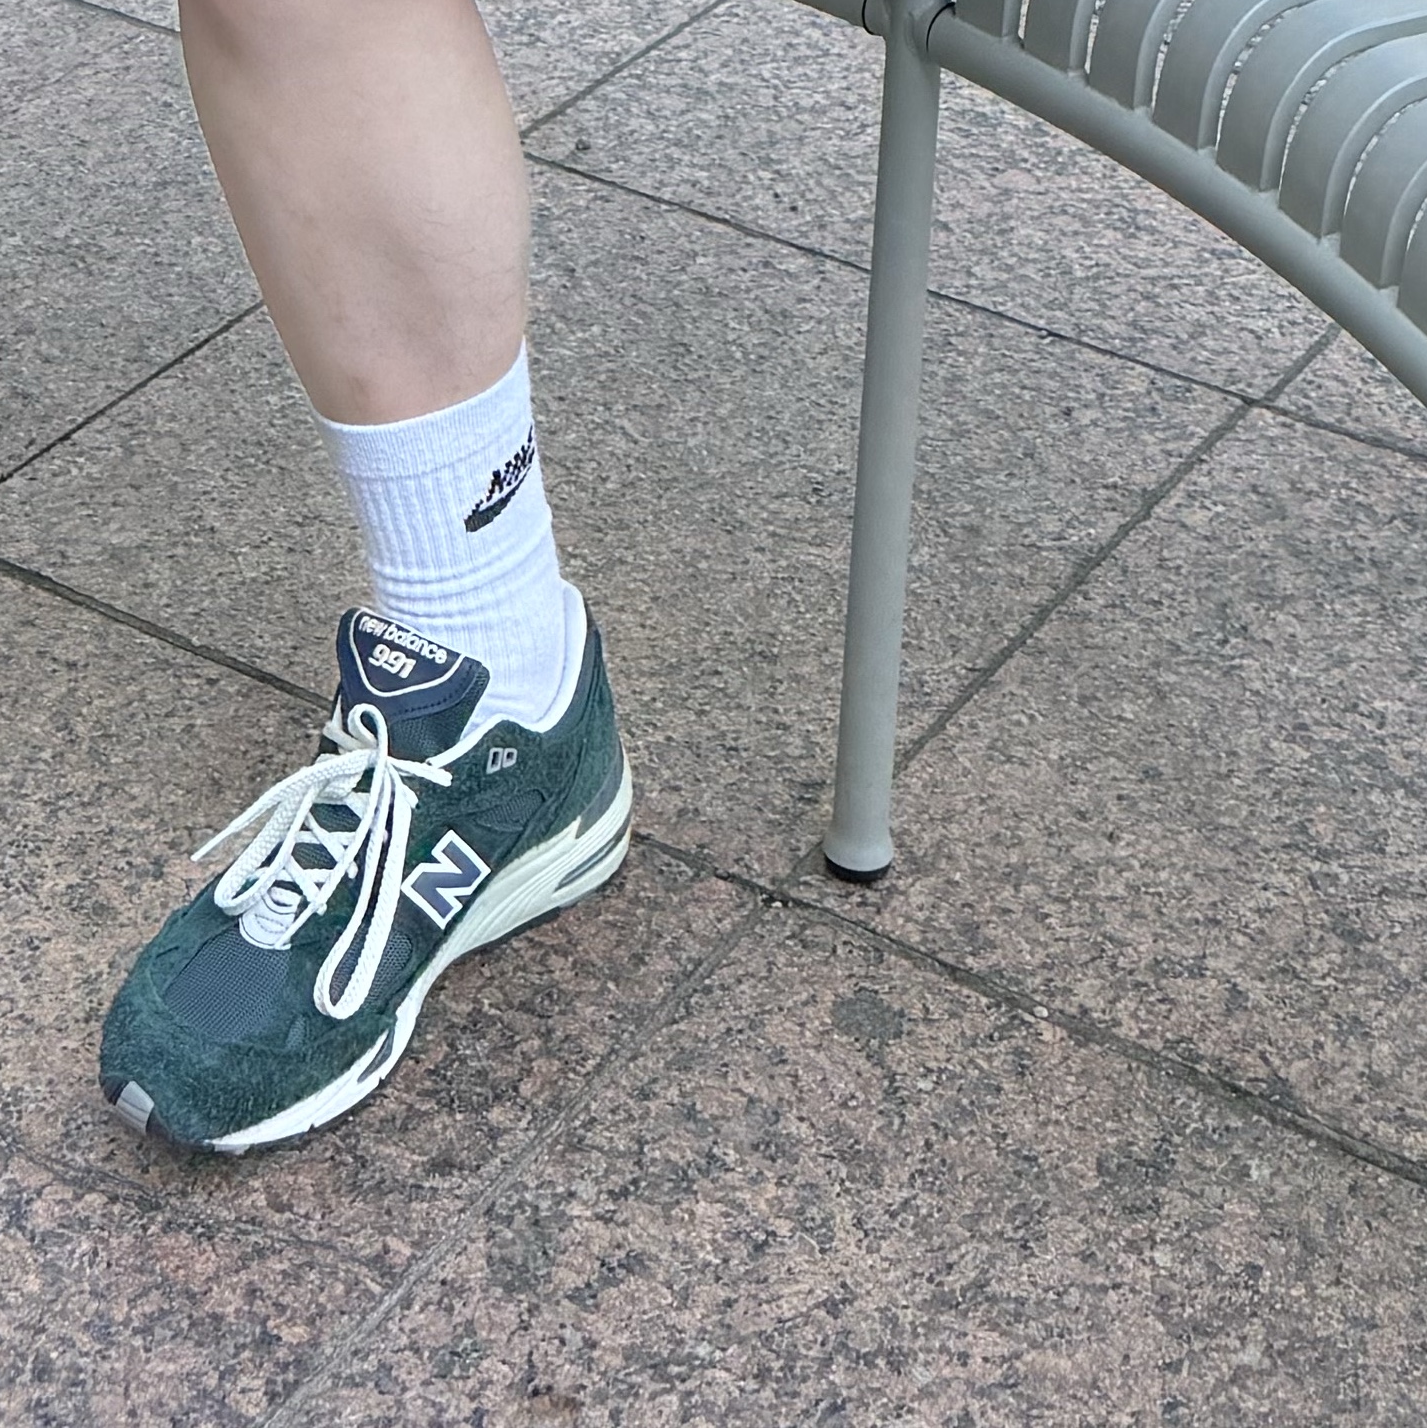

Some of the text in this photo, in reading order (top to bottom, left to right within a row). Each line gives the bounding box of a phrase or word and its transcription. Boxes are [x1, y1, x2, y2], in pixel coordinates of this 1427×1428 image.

[358, 615, 448, 664] new balance
[368, 643, 417, 679] 991
[400, 829, 492, 930] N
